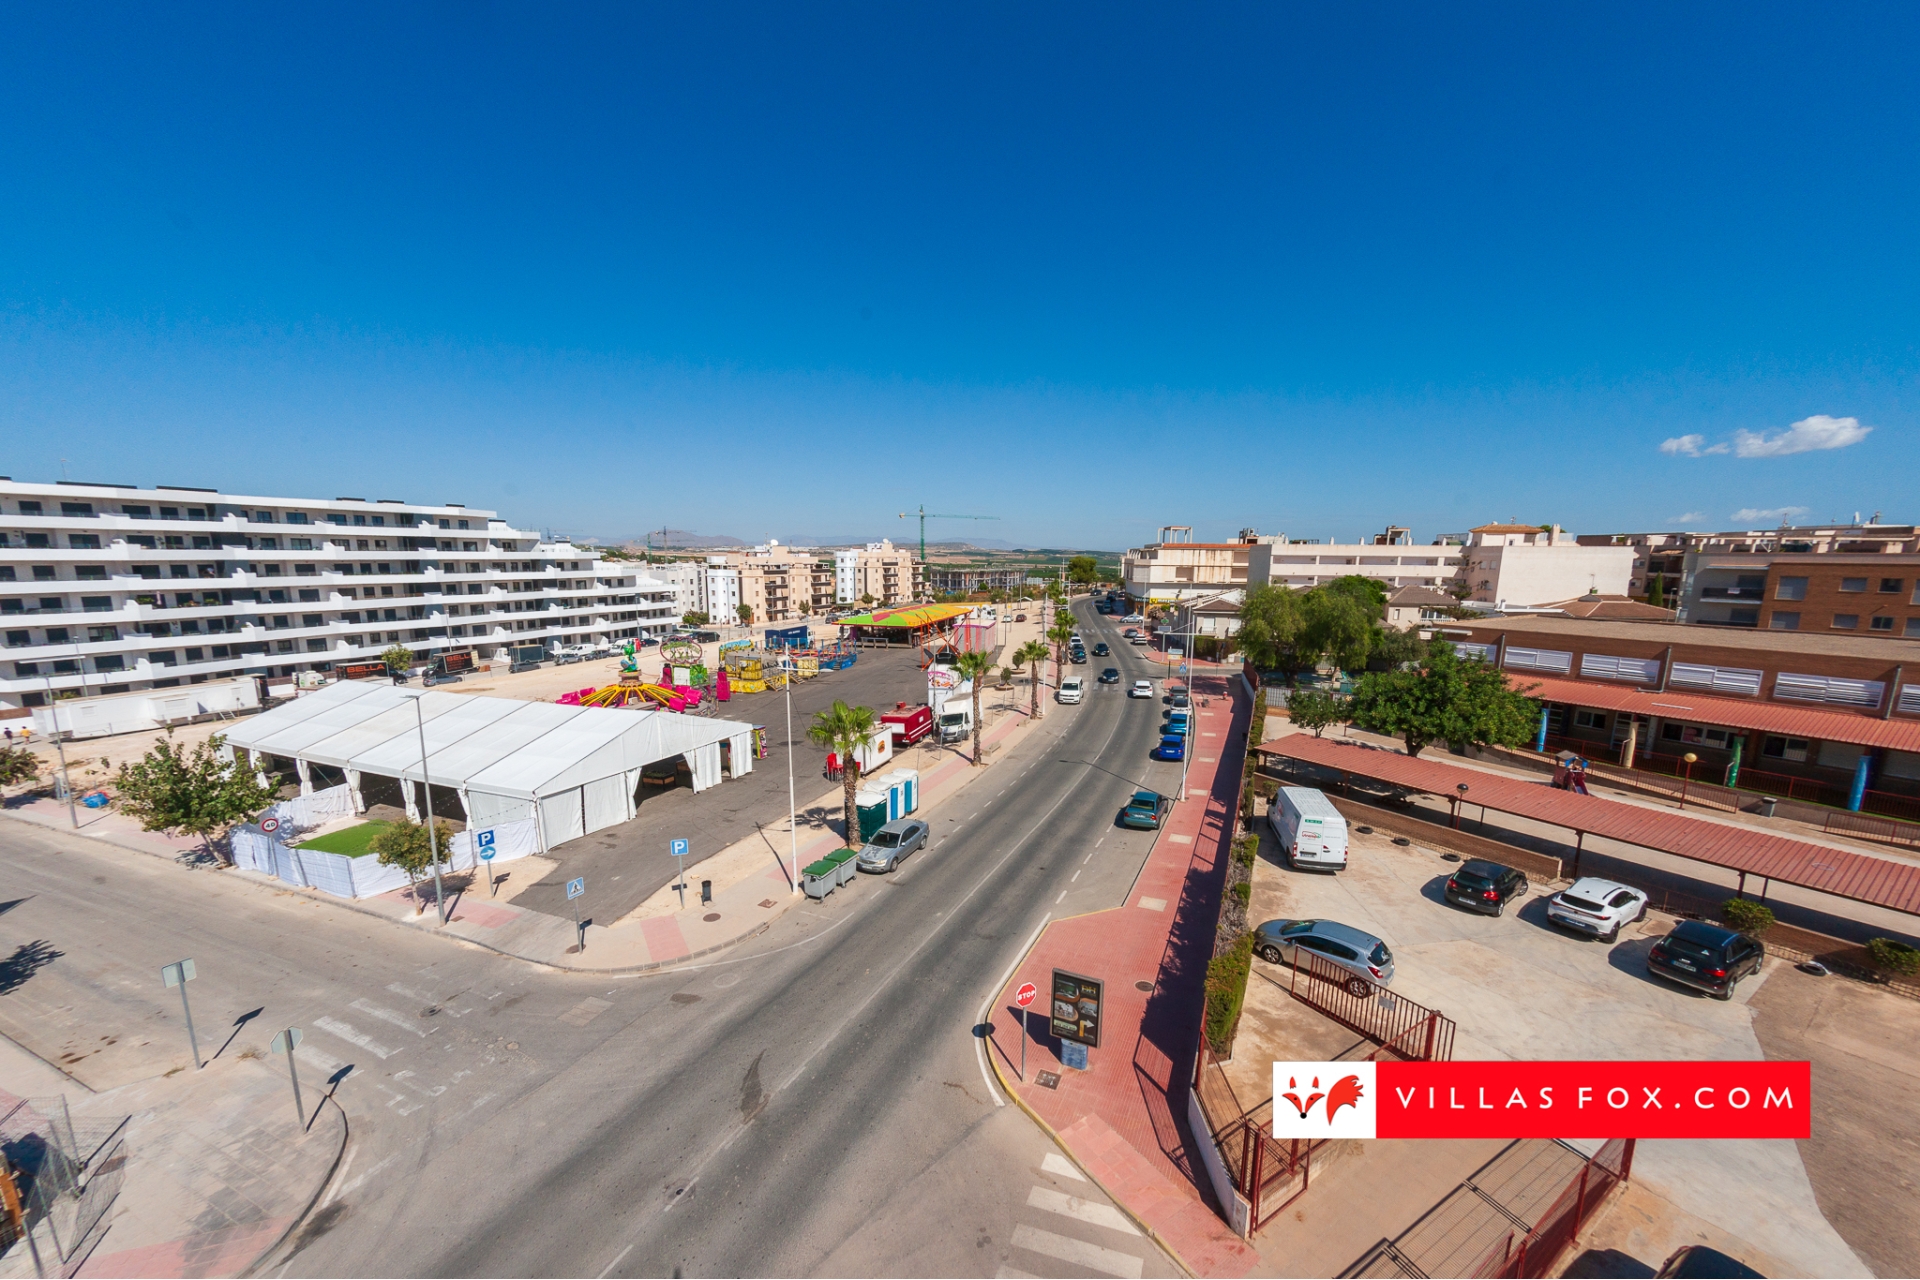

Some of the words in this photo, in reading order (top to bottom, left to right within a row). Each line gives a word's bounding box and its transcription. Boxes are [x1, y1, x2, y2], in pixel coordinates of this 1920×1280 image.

[347, 664, 385, 673] BELLA
[481, 832, 492, 845] P
[674, 841, 684, 853] P
[1018, 990, 1035, 1001] STOP
